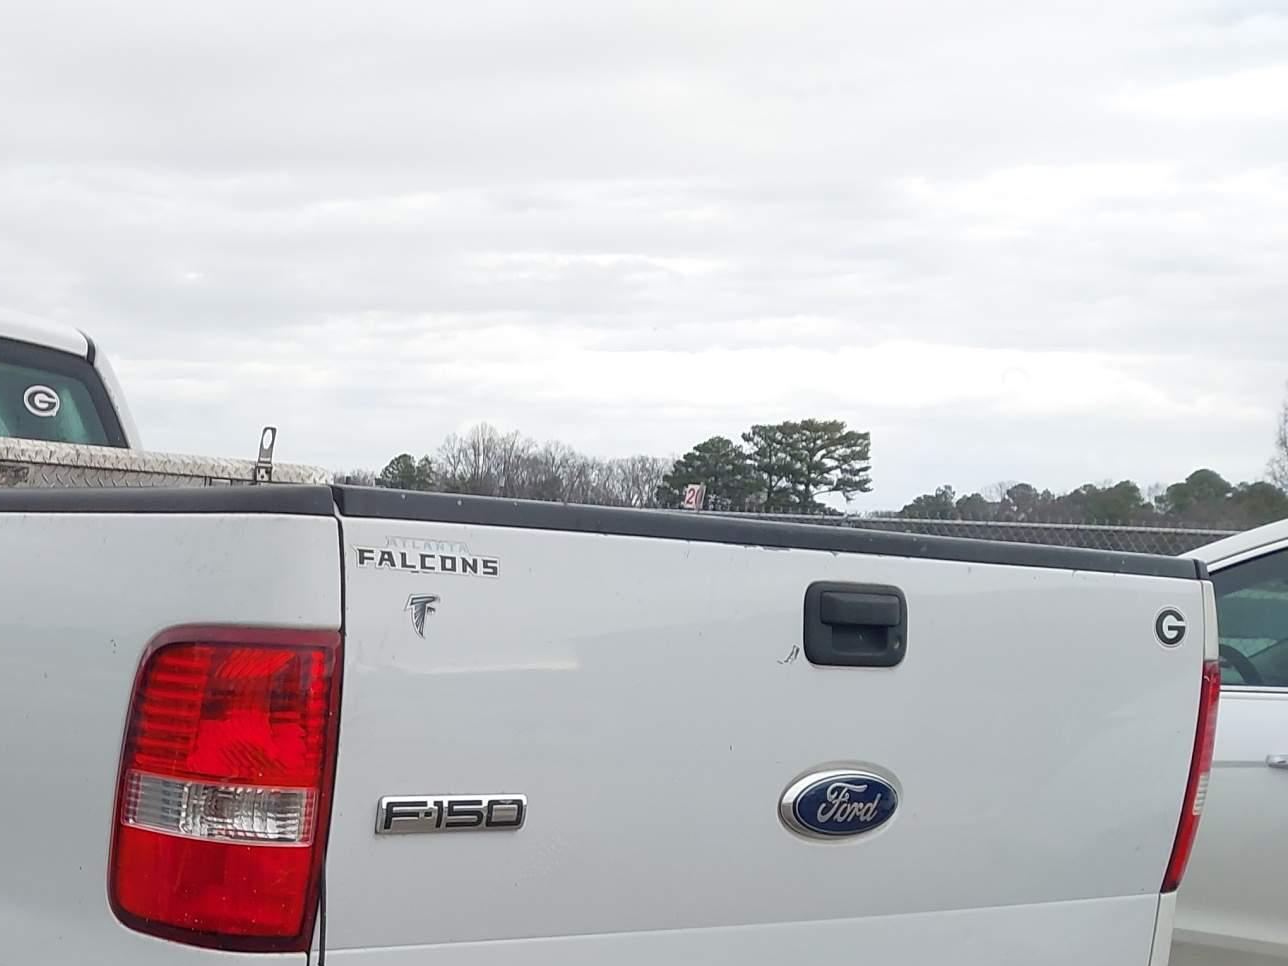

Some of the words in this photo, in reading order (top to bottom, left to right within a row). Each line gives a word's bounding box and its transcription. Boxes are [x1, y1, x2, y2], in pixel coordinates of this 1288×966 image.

[26, 388, 58, 413] G
[357, 548, 498, 576] FALCONS
[1155, 609, 1186, 645] G
[383, 799, 524, 830] F-150
[817, 782, 882, 823] Ford
